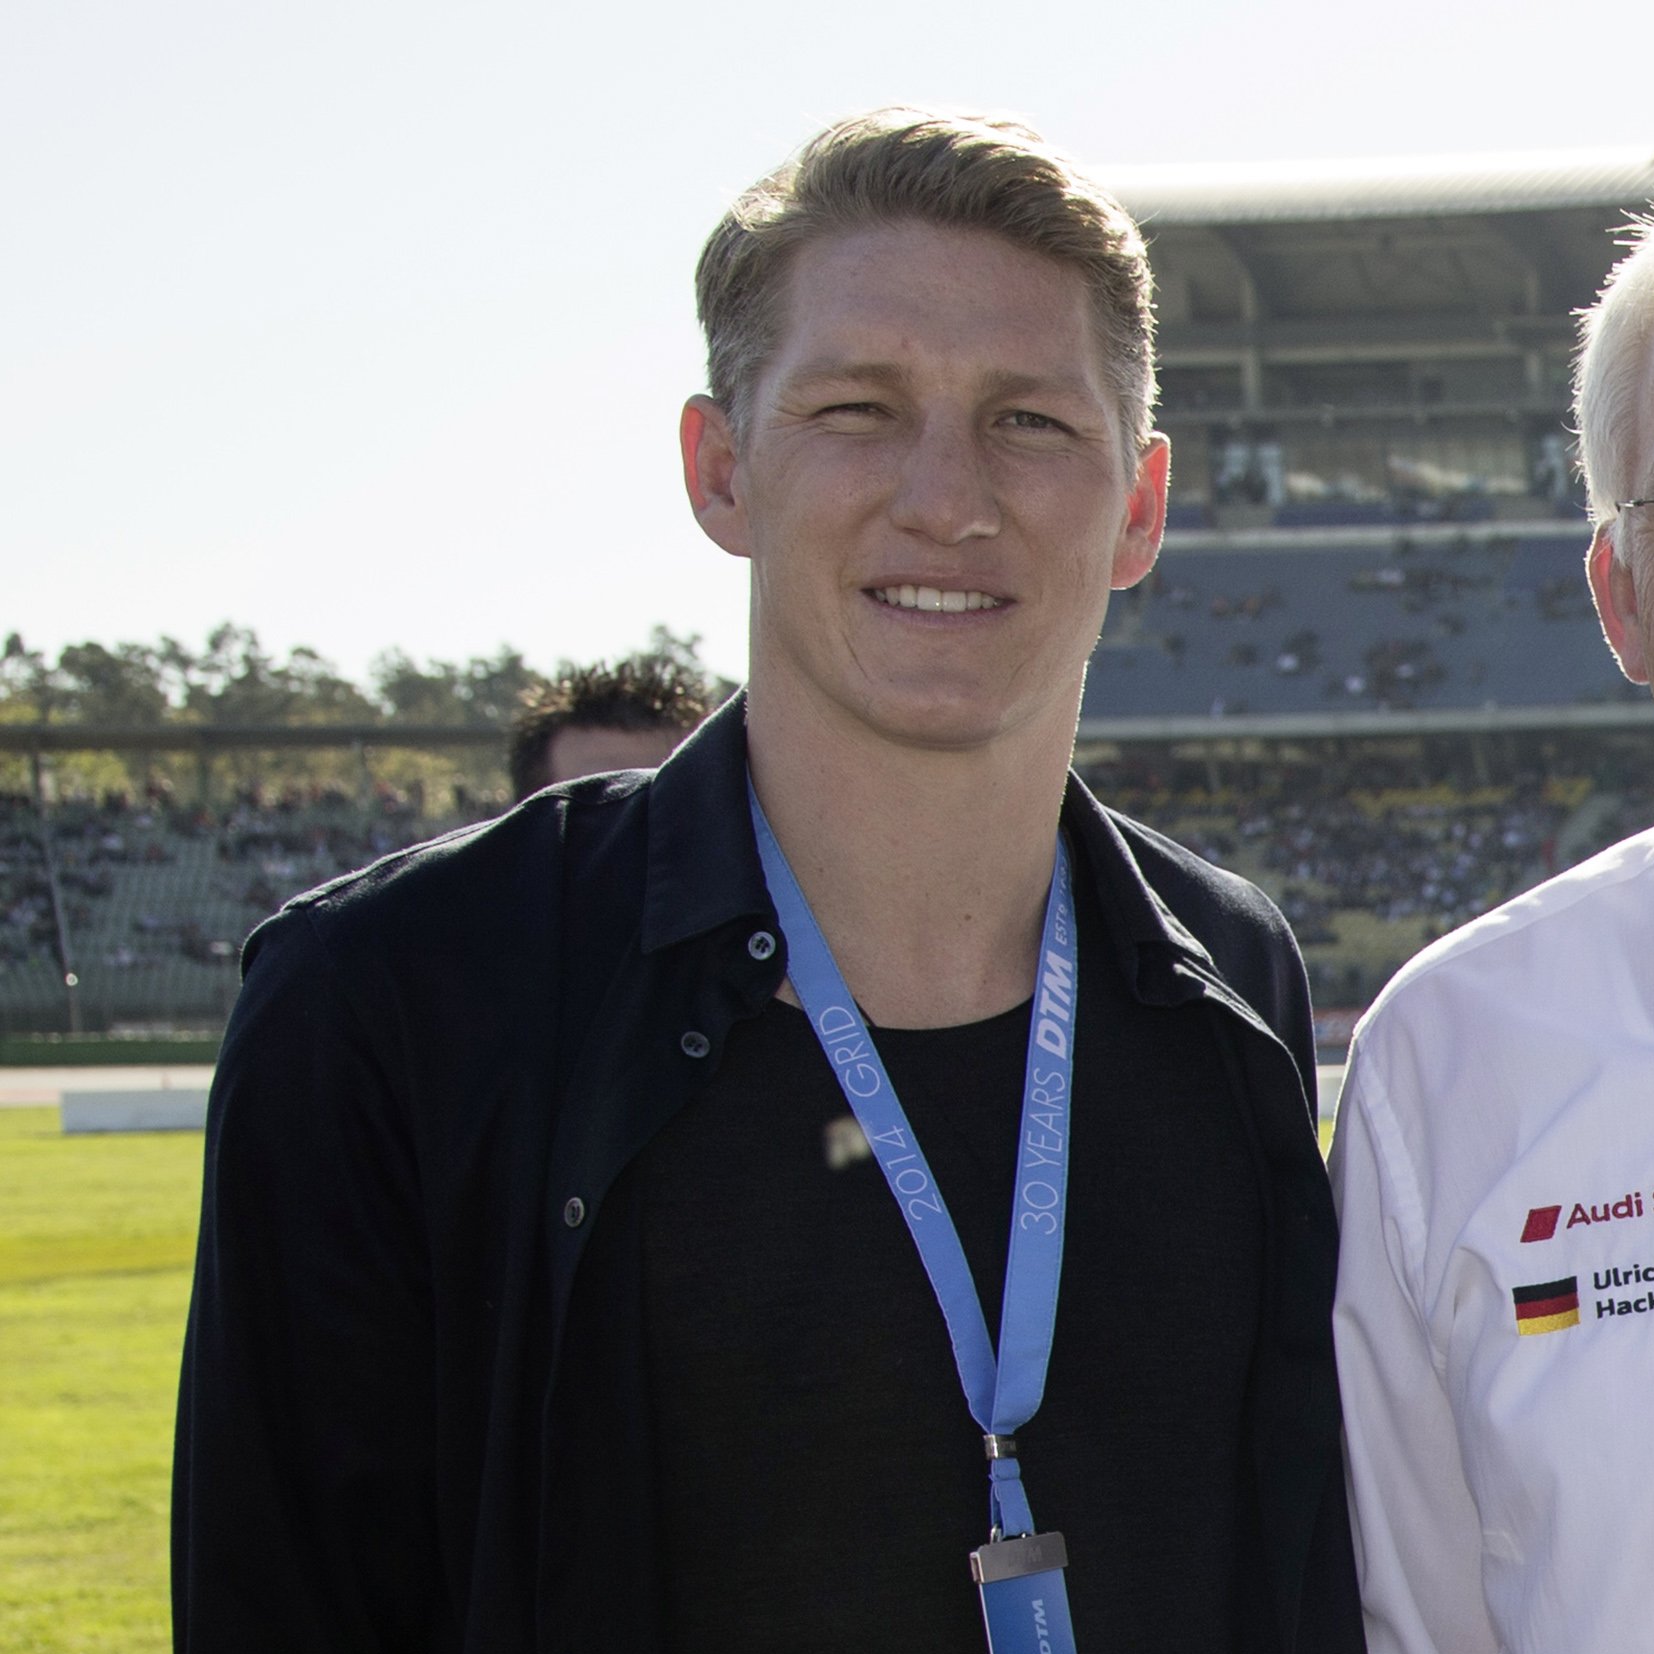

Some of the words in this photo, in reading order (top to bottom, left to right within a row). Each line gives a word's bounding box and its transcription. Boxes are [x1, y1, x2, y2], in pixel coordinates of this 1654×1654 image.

[819, 1006, 881, 1098] GRID
[1036, 950, 1073, 1060] DTM
[1025, 1067, 1066, 1168] YEARS
[873, 1125, 944, 1221] 2014
[1020, 1181, 1059, 1236] 30
[1566, 1192, 1644, 1229] Audi
